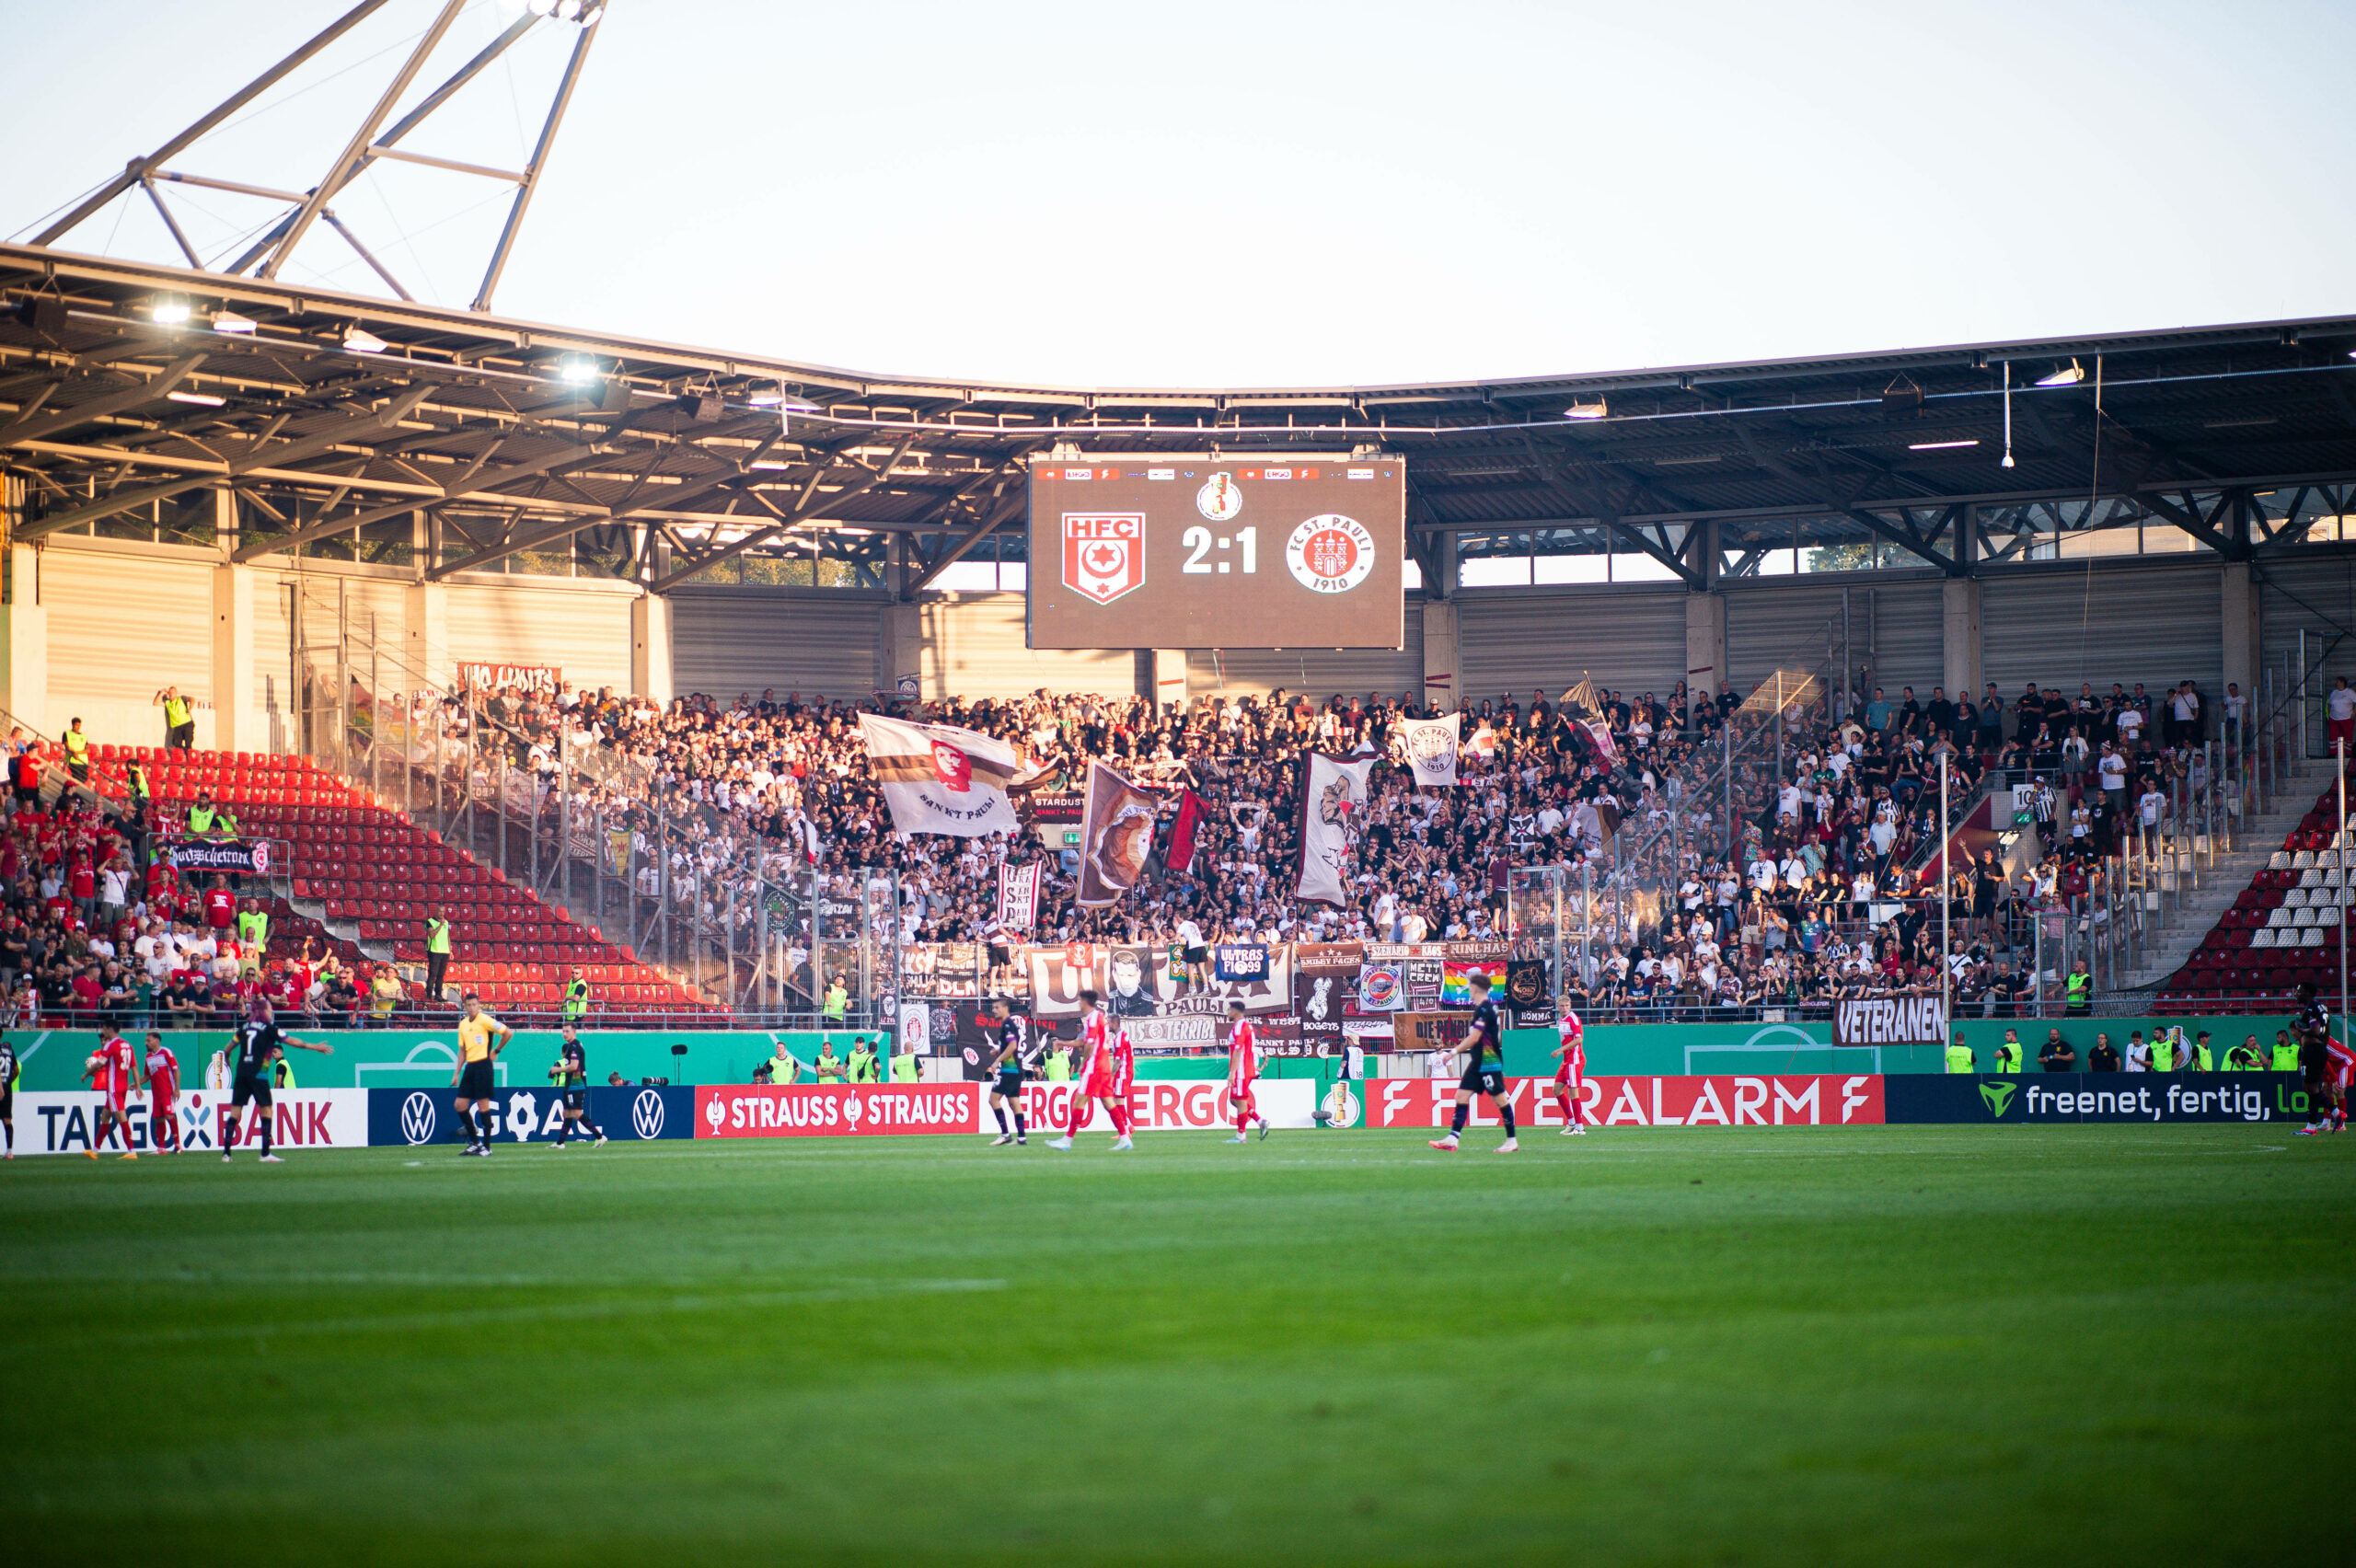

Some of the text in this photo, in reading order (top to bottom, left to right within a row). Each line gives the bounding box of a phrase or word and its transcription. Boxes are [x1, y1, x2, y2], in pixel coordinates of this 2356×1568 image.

[1071, 519, 1135, 537] HFC
[1332, 515, 1372, 553] PAULI
[1182, 525, 1257, 574] 2:1
[1312, 577, 1349, 592] 1910
[1426, 762, 1445, 771] 1910
[920, 792, 996, 821] SANKT PAULI
[1034, 798, 1085, 806] STARDUST
[1220, 949, 1264, 962] ULTRAS
[1370, 945, 1443, 957] SZENARIO KAOS
[1449, 942, 1509, 954] HINCHAS
[1301, 956, 1361, 966] SMILEY FACES
[1409, 963, 1440, 973] METT
[1409, 973, 1440, 983] CREW
[1165, 997, 1226, 1015] PAULI
[1520, 1010, 1552, 1021] HÖMMA
[1838, 997, 1945, 1043] VETERANEN
[1302, 1021, 1340, 1032] BOGEYS
[1415, 1020, 1435, 1039] DIE
[246, 1030, 258, 1055] 7
[120, 1048, 132, 1070] 31
[1127, 1084, 1256, 1127] ERGO
[1431, 1076, 1820, 1126] FLYERALARM
[2026, 1084, 2161, 1121] freenet,
[2166, 1084, 2270, 1121] fertig,
[731, 1092, 970, 1129] STRAUSS STRAUSS
[216, 1101, 333, 1147] BANK
